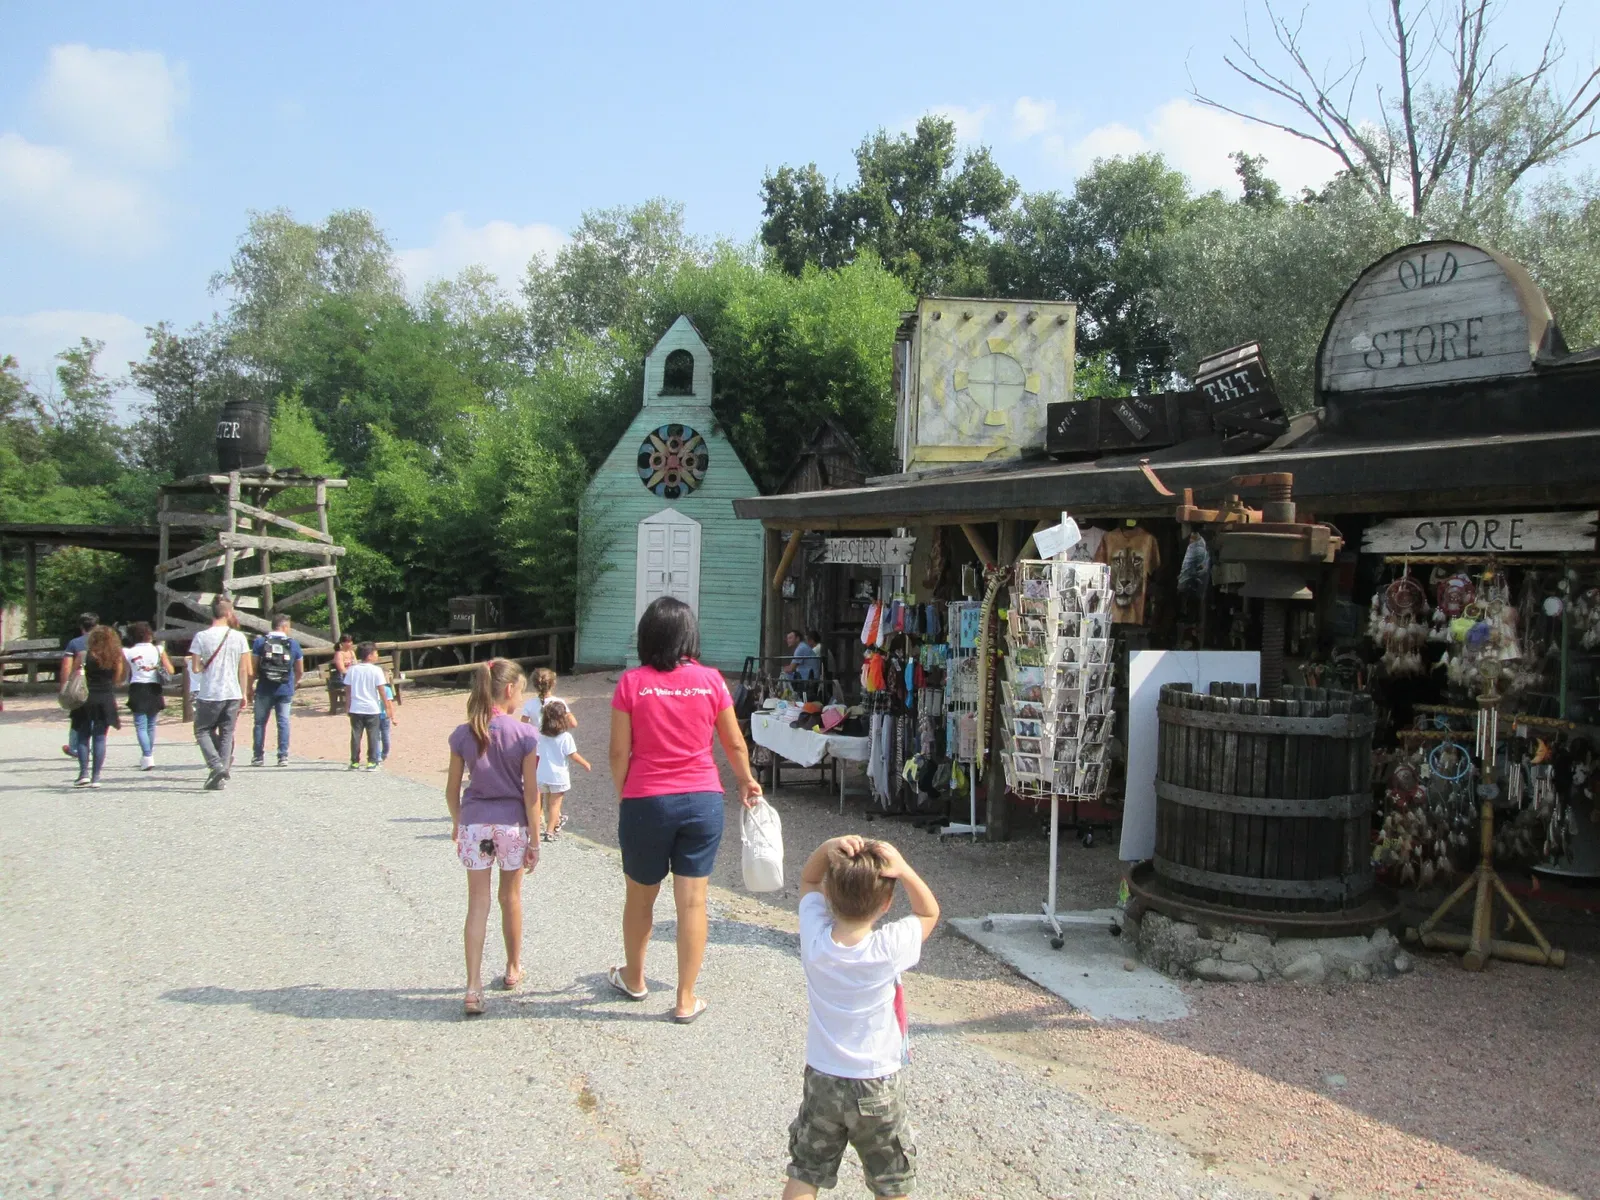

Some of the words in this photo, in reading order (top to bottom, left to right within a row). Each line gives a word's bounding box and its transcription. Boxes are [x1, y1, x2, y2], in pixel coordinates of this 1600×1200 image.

[1399, 251, 1458, 290] OLD
[1363, 316, 1483, 370] STORE
[830, 540, 887, 564] WESTERN
[1410, 518, 1524, 551] STORE
